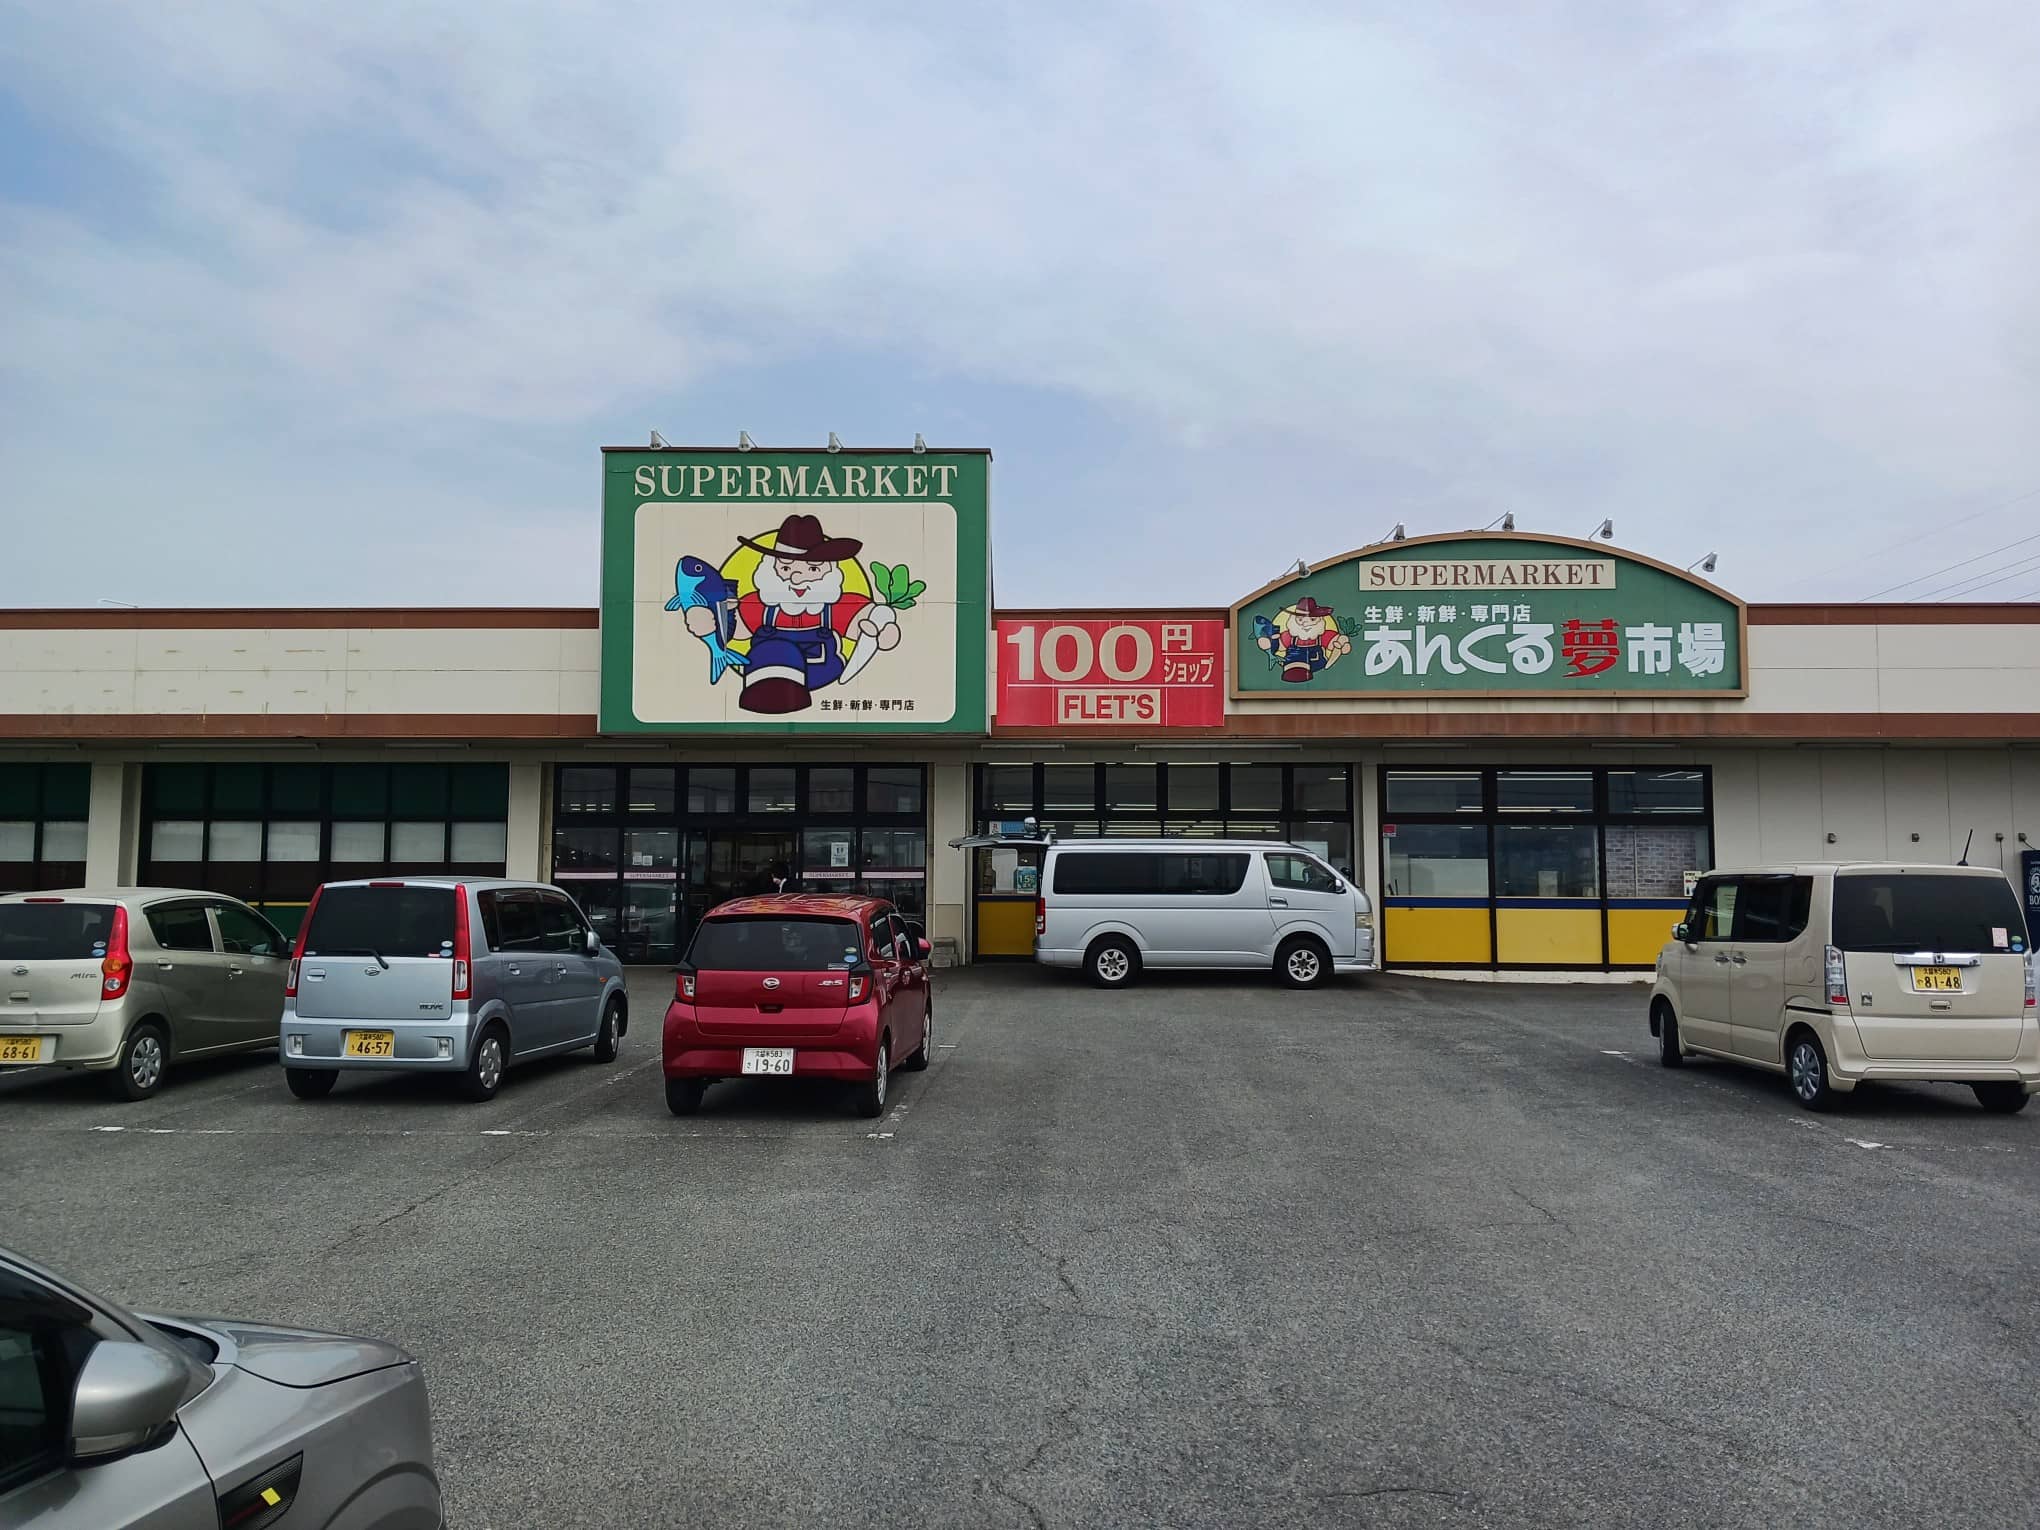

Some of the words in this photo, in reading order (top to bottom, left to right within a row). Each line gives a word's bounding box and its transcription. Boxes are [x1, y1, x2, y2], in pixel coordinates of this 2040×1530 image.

[633, 464, 959, 498] SUPERMARKET
[1369, 563, 1605, 587] SUPERMARKET
[1161, 624, 1193, 651] 円
[1006, 624, 1155, 683] 100
[1163, 656, 1214, 683] ショップ
[1063, 693, 1154, 719] FLET'S
[1924, 976, 1961, 989] 81-48
[357, 1041, 391, 1054] 46-57
[755, 1058, 790, 1072] 19-60
